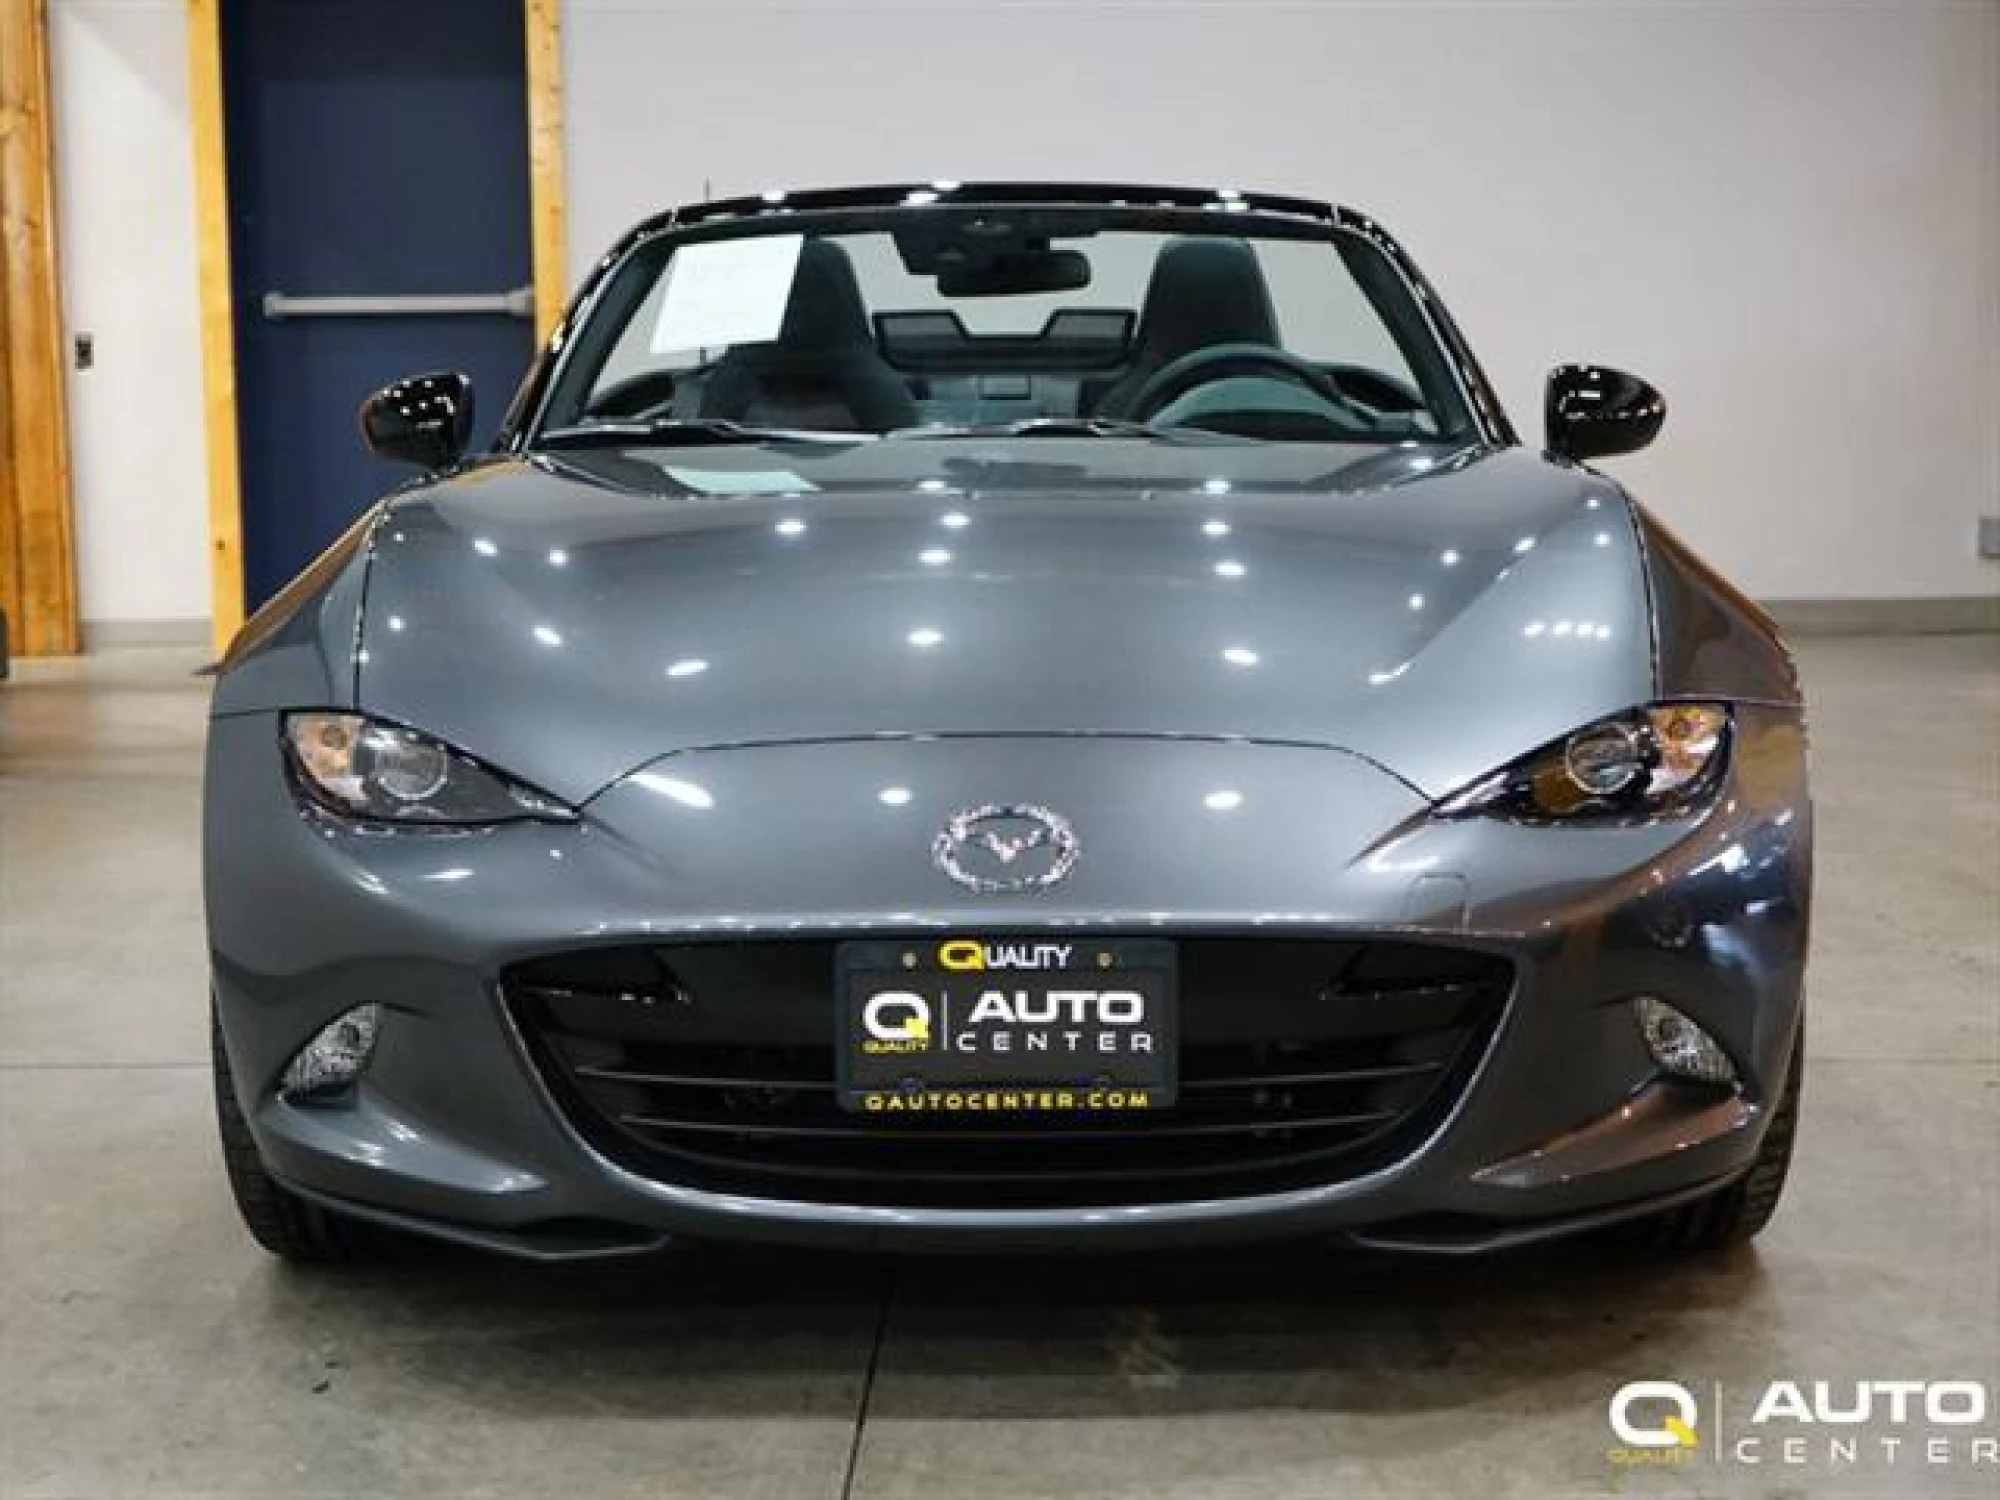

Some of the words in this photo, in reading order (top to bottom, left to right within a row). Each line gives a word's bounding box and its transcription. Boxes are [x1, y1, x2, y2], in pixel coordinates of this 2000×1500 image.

[938, 940, 1072, 969] QUALITY
[969, 990, 1144, 1023] AUTO
[956, 1031, 1153, 1052] CENTER
